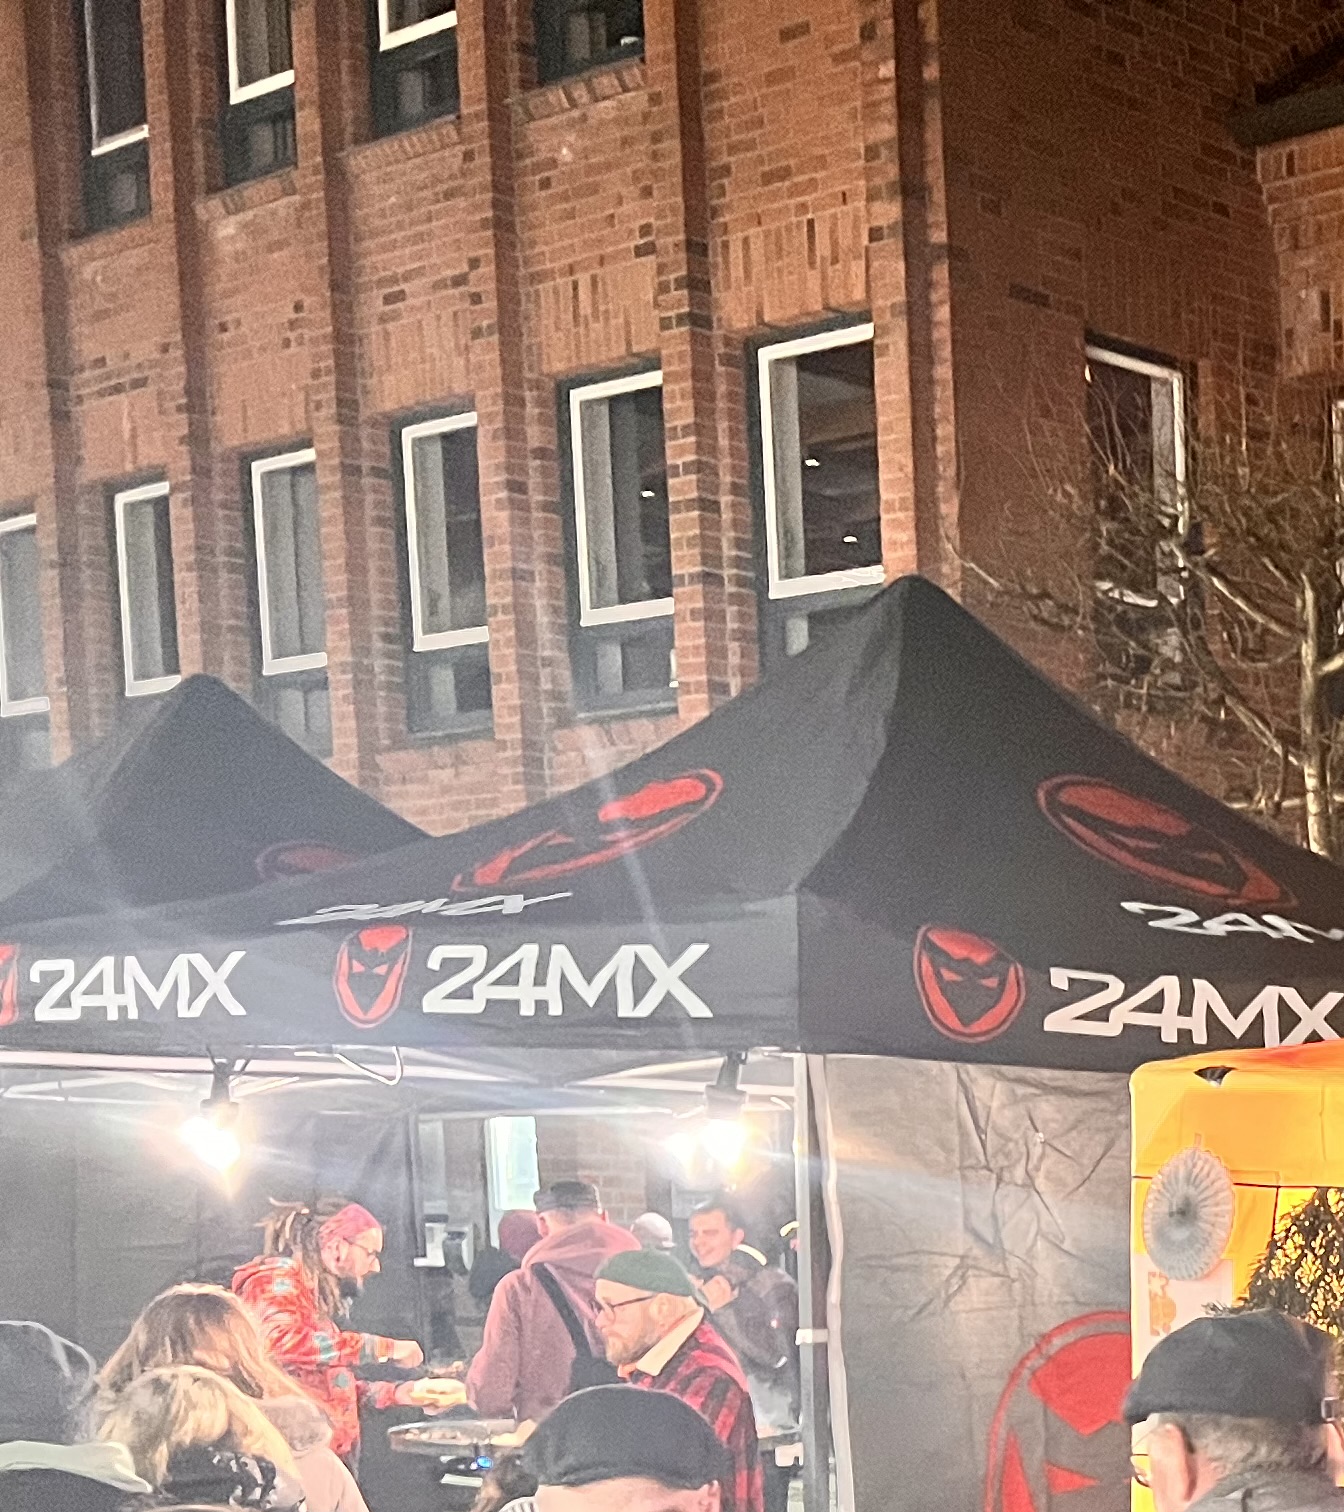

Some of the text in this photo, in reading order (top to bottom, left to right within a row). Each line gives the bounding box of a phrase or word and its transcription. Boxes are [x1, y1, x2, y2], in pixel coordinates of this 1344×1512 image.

[30, 950, 247, 1022] 24MX
[423, 943, 713, 1018] 24MX
[1043, 967, 1344, 1049] 24MX
